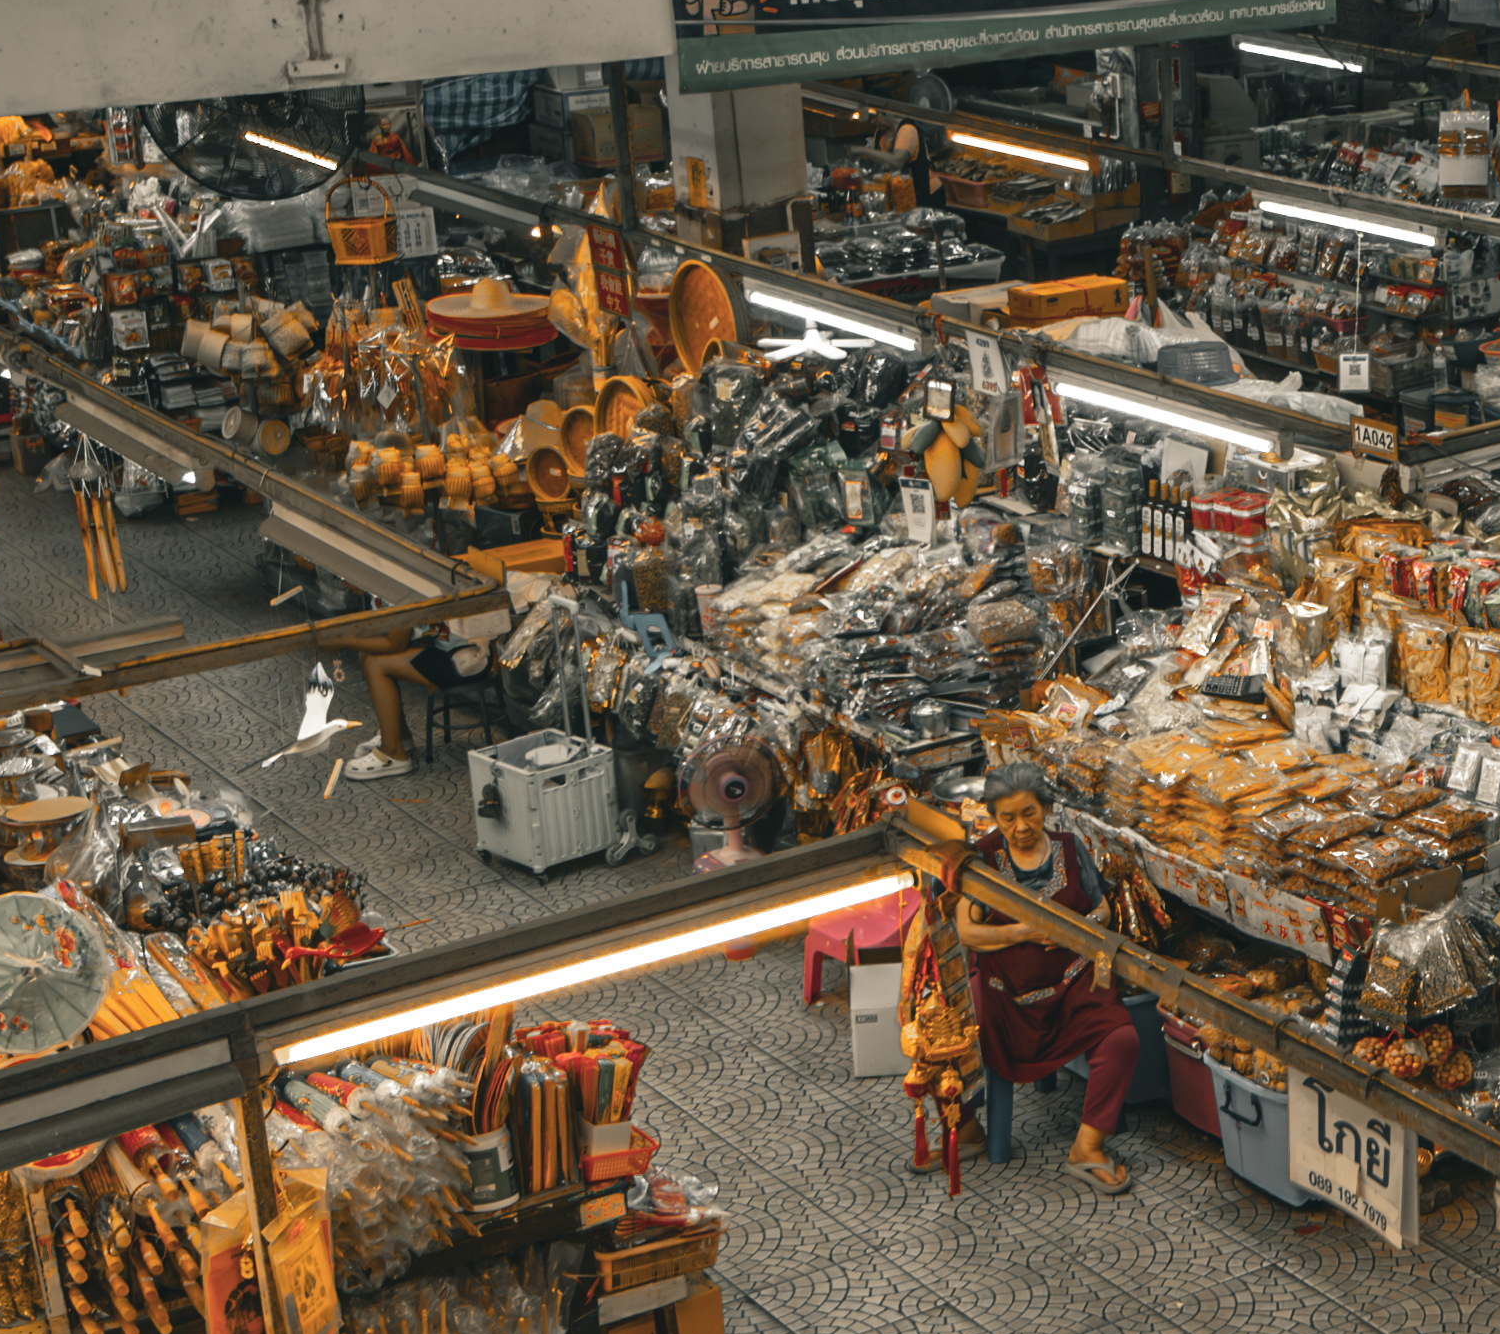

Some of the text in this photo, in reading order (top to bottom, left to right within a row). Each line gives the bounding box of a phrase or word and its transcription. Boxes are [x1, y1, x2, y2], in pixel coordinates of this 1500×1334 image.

[1354, 423, 1395, 451] 1A042
[1308, 1170, 1388, 1232] 089 192 7979
